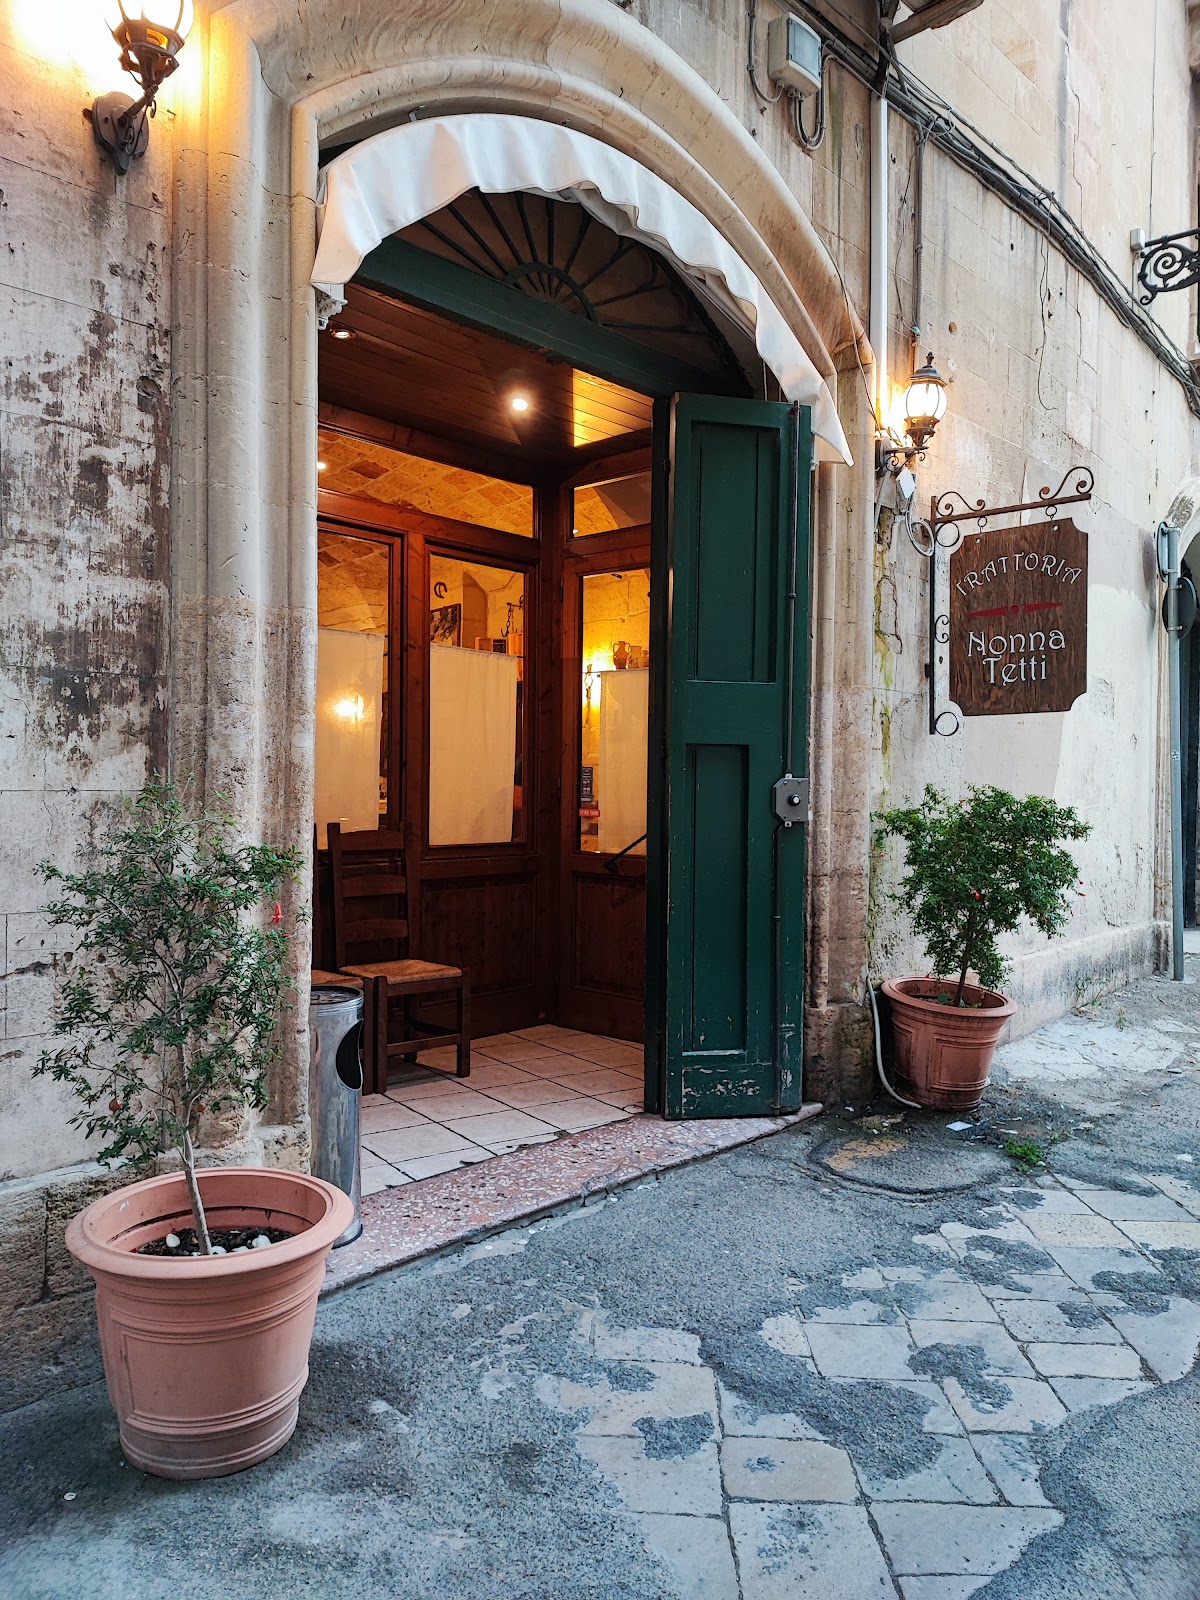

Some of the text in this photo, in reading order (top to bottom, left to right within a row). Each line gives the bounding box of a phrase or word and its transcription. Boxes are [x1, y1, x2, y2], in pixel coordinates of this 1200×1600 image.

[956, 552, 1082, 596] TRATTORIA
[968, 629, 1066, 657] Nonna
[982, 654, 1047, 686] Tetti
